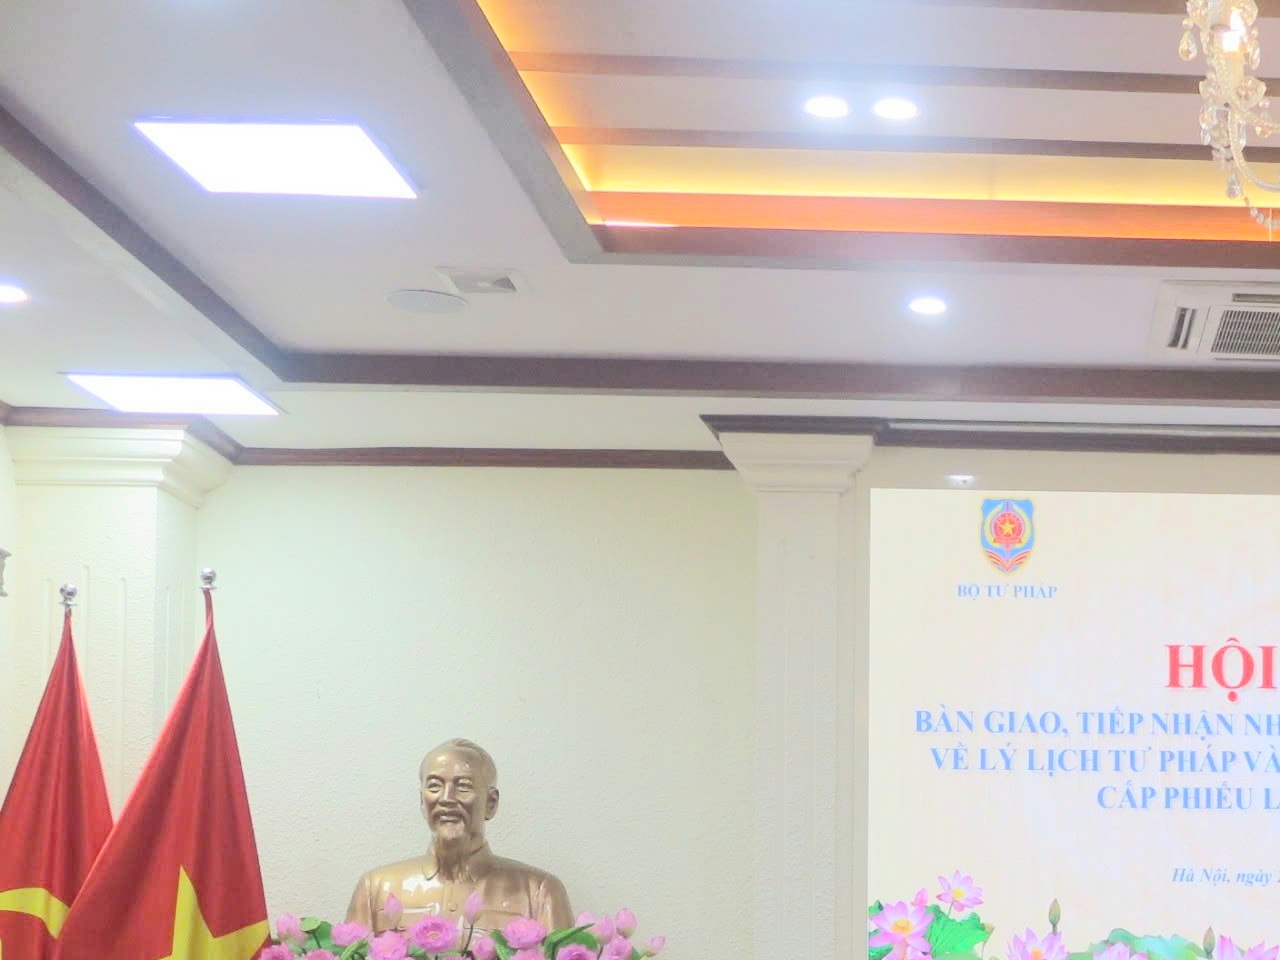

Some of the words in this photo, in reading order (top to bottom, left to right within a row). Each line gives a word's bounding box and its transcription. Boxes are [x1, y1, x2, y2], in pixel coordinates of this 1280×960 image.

[985, 583, 1010, 597] TƯ
[1014, 582, 1058, 598] PHÁP
[1164, 637, 1278, 702] HỘI
[914, 704, 975, 734] BÀN
[984, 710, 1069, 736] GIAO,
[1076, 705, 1144, 735] TIẾP
[1151, 709, 1234, 741] NHẬN
[930, 741, 969, 771] VỀ
[978, 742, 1017, 771] LÝ
[1026, 748, 1101, 777] LỊCH
[1107, 746, 1152, 772] TƯ
[1159, 744, 1237, 773] PHÁP
[1097, 779, 1157, 809] CẤP
[1163, 781, 1253, 810] PHIẾU
[1171, 868, 1195, 883] Hà
[1199, 868, 1231, 886] Nội,
[1236, 868, 1273, 887] ngày
